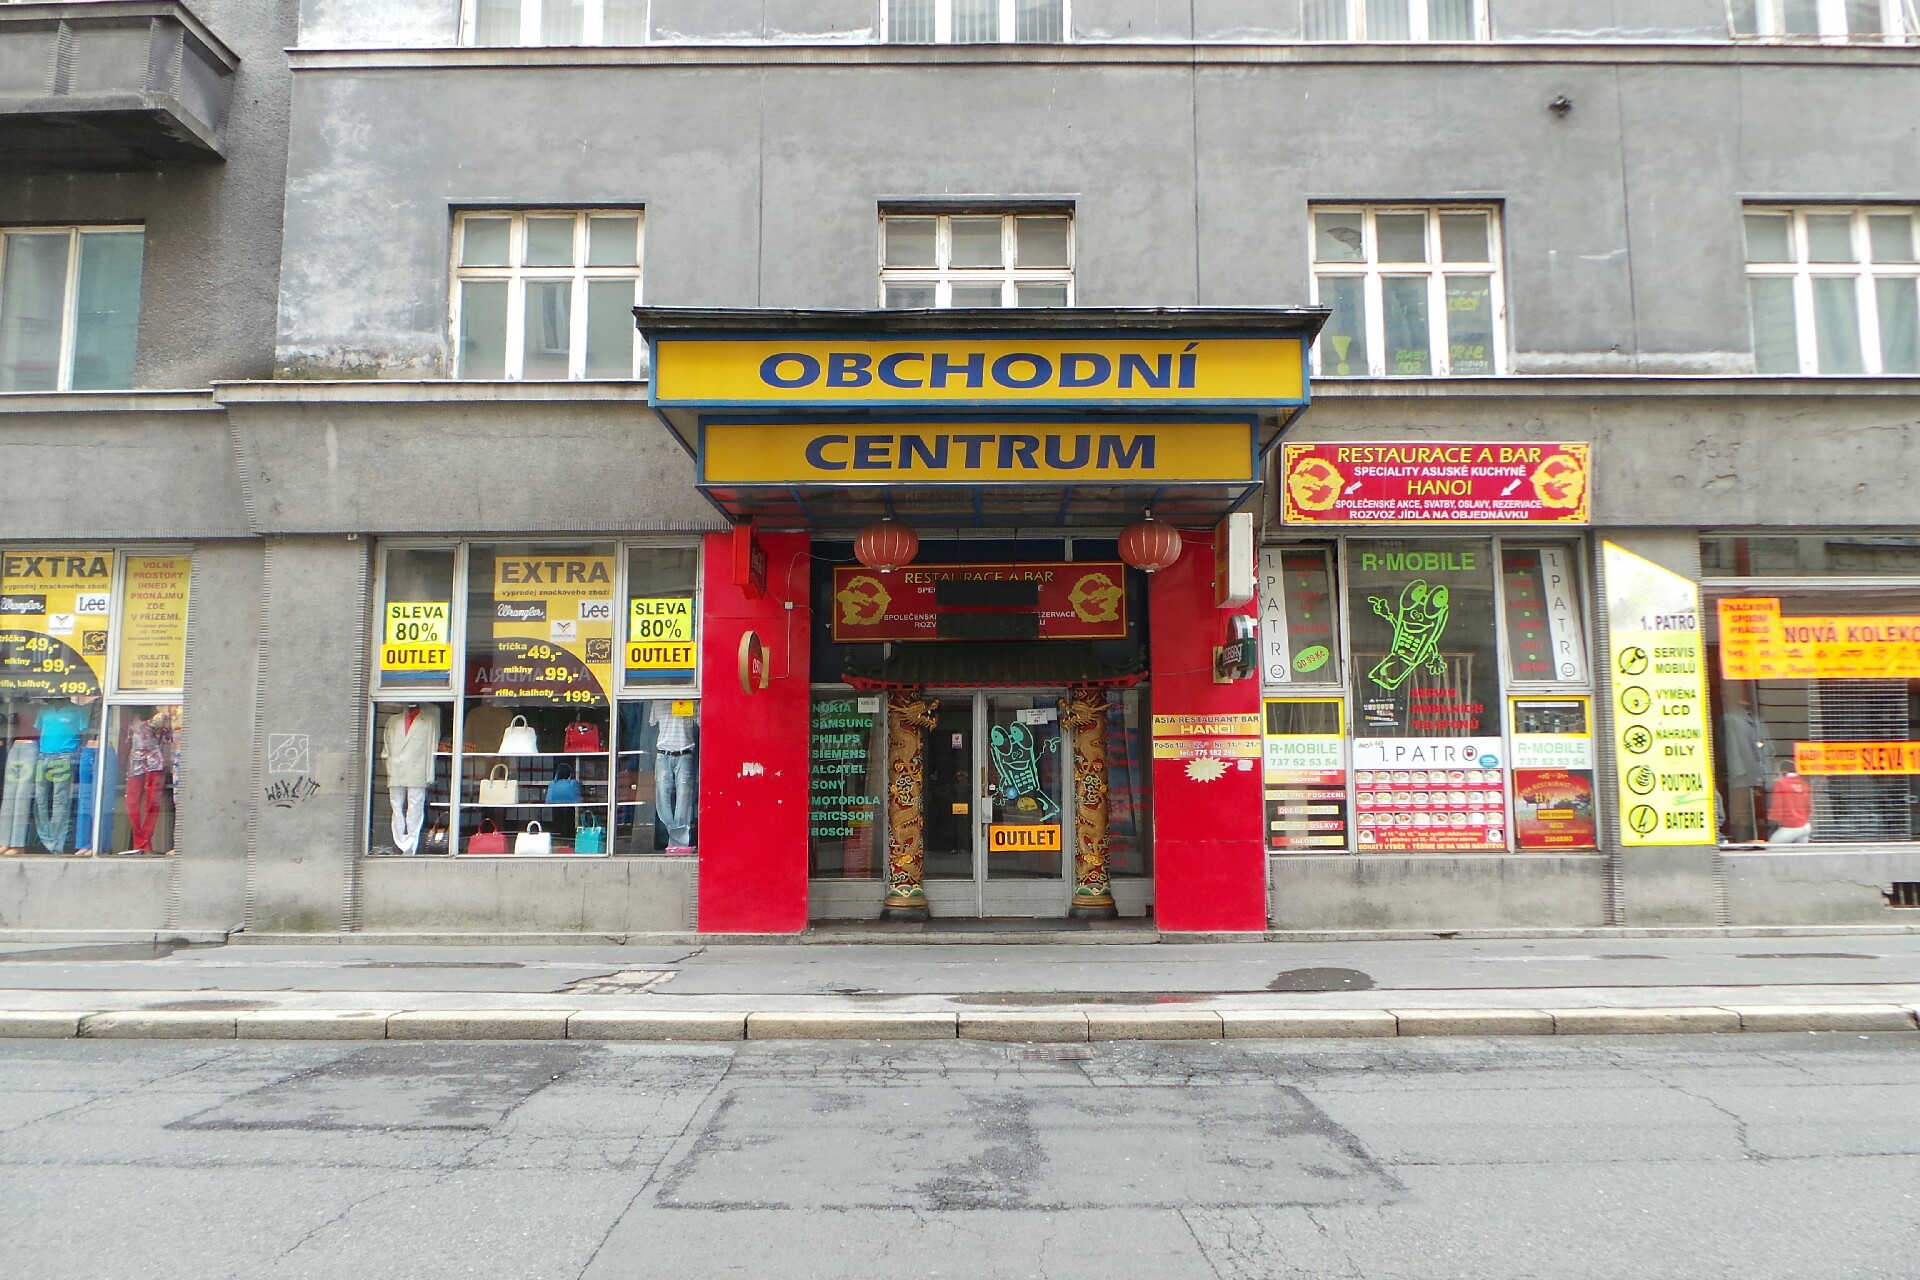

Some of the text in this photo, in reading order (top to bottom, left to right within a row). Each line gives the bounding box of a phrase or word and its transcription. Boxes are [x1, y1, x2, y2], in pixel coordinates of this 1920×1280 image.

[758, 342, 1199, 389] OBCHODNÍ
[804, 434, 1156, 470] CENTRUM
[1337, 447, 1541, 463] RESTAURACE A BAR
[1354, 464, 1527, 476] SPECIALITY ASIJSKÉ KUCHYNĚ
[1408, 479, 1472, 495] HANOI
[1335, 498, 1542, 509] SPOLEČENSKÉ AKCE, SVATBY, OSLAVY, REZERVACE
[1349, 508, 1529, 519] ROZVOZ JÍDLA NA OBJEDNÁVKU
[4, 557, 109, 577] EXTRA
[502, 562, 610, 583] EXTRA
[1024, 571, 1054, 582] BAR
[502, 589, 537, 597] vyprodej
[79, 596, 106, 612] Lee
[581, 603, 609, 618] Lee
[635, 603, 687, 615] SLEVA
[392, 606, 444, 618] SLEVA
[497, 603, 544, 620] Wrangler
[884, 612, 937, 620] SPOLEČENSK
[640, 619, 682, 638] 80%
[1640, 614, 1696, 630] 1. PATRO
[396, 623, 437, 641] 80%
[1784, 621, 1838, 643] NOVÁ
[386, 649, 447, 664] OUTLET
[498, 642, 527, 650] trička
[527, 645, 562, 662] 49,-
[631, 648, 691, 663] OUTLET
[1654, 648, 1695, 657] SERVIS
[1297, 658, 1307, 669] OD
[1306, 653, 1316, 664] 99
[503, 666, 534, 674] mikiny
[545, 667, 579, 683] 99,-
[17, 680, 96, 696] kalhoty 199,-
[1411, 688, 1457, 698] SERVIS
[519, 688, 554, 699] kalhoty
[563, 690, 601, 705] 199,-
[812, 703, 852, 713] NOKIA
[1663, 705, 1690, 715] LCD
[812, 718, 873, 728] SAMSUNG
[1241, 715, 1259, 723] BAR
[1180, 725, 1235, 734] HANOI
[812, 734, 860, 743] PHILIPS
[812, 750, 866, 759] SIEMENS
[1379, 745, 1389, 762] 1.
[1665, 743, 1695, 756] DÍLY
[1271, 758, 1338, 766] 737 52 53 54
[1519, 757, 1586, 766] 737 52 53 54
[1862, 748, 1905, 770] SLEVA
[812, 765, 865, 774] ALCATEL
[812, 781, 846, 790] SONY
[812, 796, 880, 805] MOTOROLA
[811, 812, 874, 821] ERICSSON
[1666, 812, 1704, 829] BATERIE
[811, 828, 853, 836] BOSCH
[995, 830, 1056, 846] OUTLET
